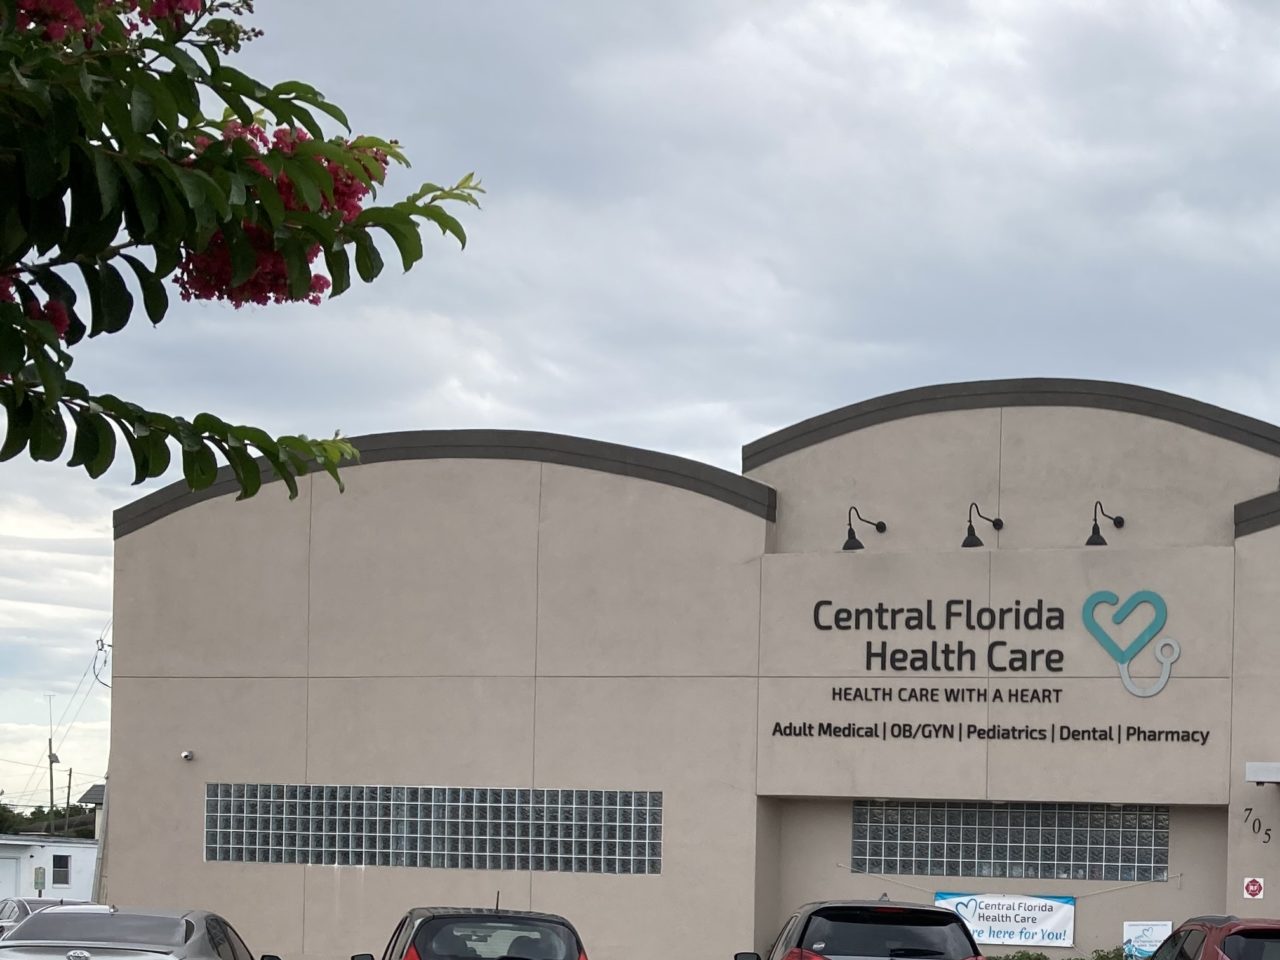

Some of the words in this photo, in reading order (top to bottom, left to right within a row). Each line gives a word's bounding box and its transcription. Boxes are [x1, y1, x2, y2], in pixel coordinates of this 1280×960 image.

[813, 599, 936, 631] Central
[945, 599, 1065, 631] Florida
[866, 640, 976, 672] Health
[987, 640, 1064, 673] Care
[831, 687, 892, 702] HEALTH
[898, 687, 940, 703] CARE
[944, 687, 988, 703] WITH
[992, 688, 1004, 703] A
[1008, 688, 1063, 704] HEART
[771, 721, 814, 738] Adult
[818, 722, 879, 739] Medical
[890, 723, 955, 741] OB/GYN
[966, 724, 1047, 742] Pediatrics
[1059, 725, 1114, 742] Dental
[1126, 725, 1210, 746] Pharmacy
[1244, 807, 1272, 844] 705
[977, 900, 1016, 912] Central
[1017, 902, 1054, 913] Florida
[977, 912, 1012, 923] Health
[1014, 913, 1037, 924] Care
[988, 926, 1015, 939] here
[1018, 927, 1038, 941] for
[1040, 929, 1068, 941] You!
